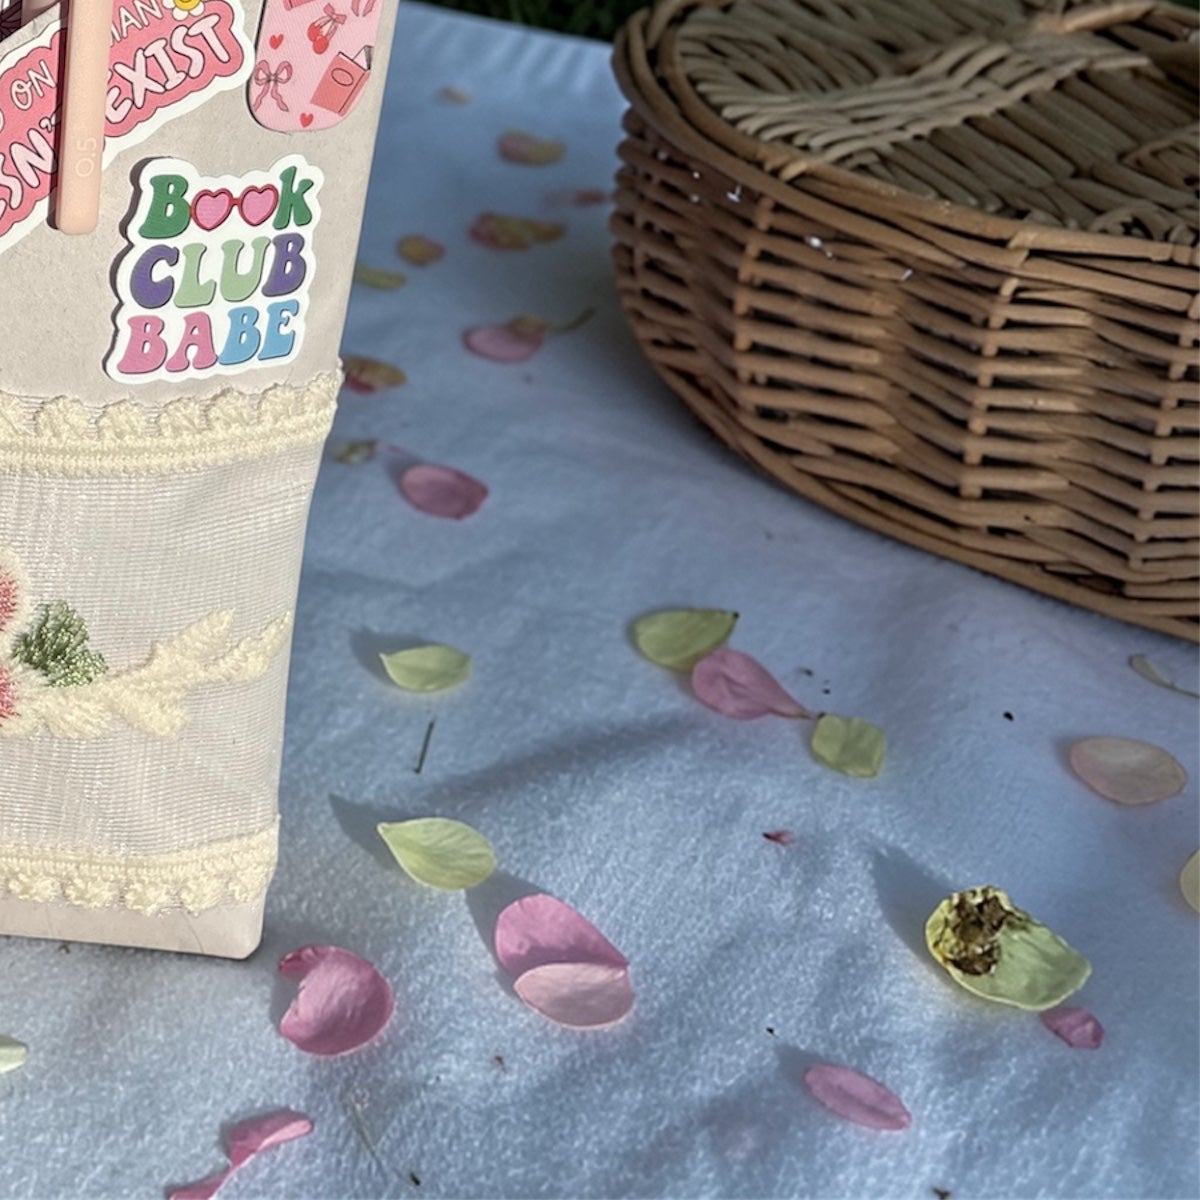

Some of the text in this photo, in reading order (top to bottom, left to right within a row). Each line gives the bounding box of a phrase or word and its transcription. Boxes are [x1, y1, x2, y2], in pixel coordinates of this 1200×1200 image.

[10, 59, 58, 111] ON
[129, 232, 308, 310] CLUB
[116, 299, 300, 375] BABE
